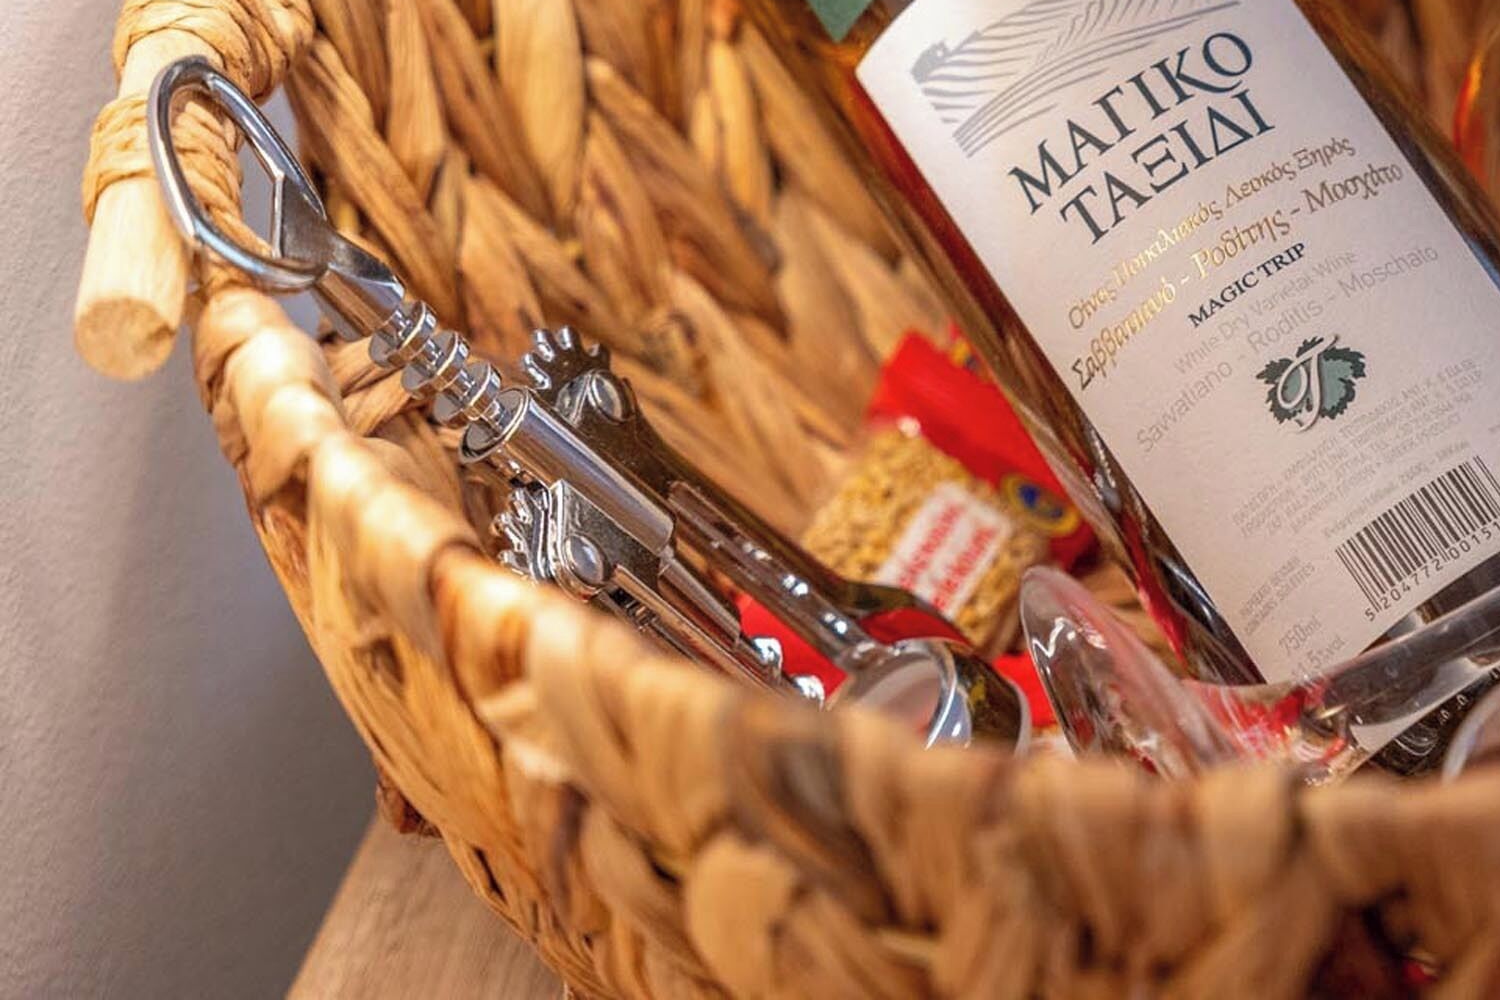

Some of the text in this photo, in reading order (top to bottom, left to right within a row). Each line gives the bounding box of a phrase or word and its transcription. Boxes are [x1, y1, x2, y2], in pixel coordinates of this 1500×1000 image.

[1008, 32, 1253, 214] ΜΑΓΙΚΟ
[1060, 89, 1275, 245] ΤΑΞΙΔΙ
[1225, 161, 1297, 208] Λευκός
[1294, 137, 1356, 172] Ξηρός
[1190, 210, 1291, 280] Ροδίτης
[1301, 162, 1403, 214] Μοσχάτο
[1174, 251, 1358, 375] White Dry Varietal Wine
[1187, 242, 1306, 328] MAGIC TRIP
[1247, 300, 1323, 353] Roditis
[1338, 245, 1439, 298] Moschato
